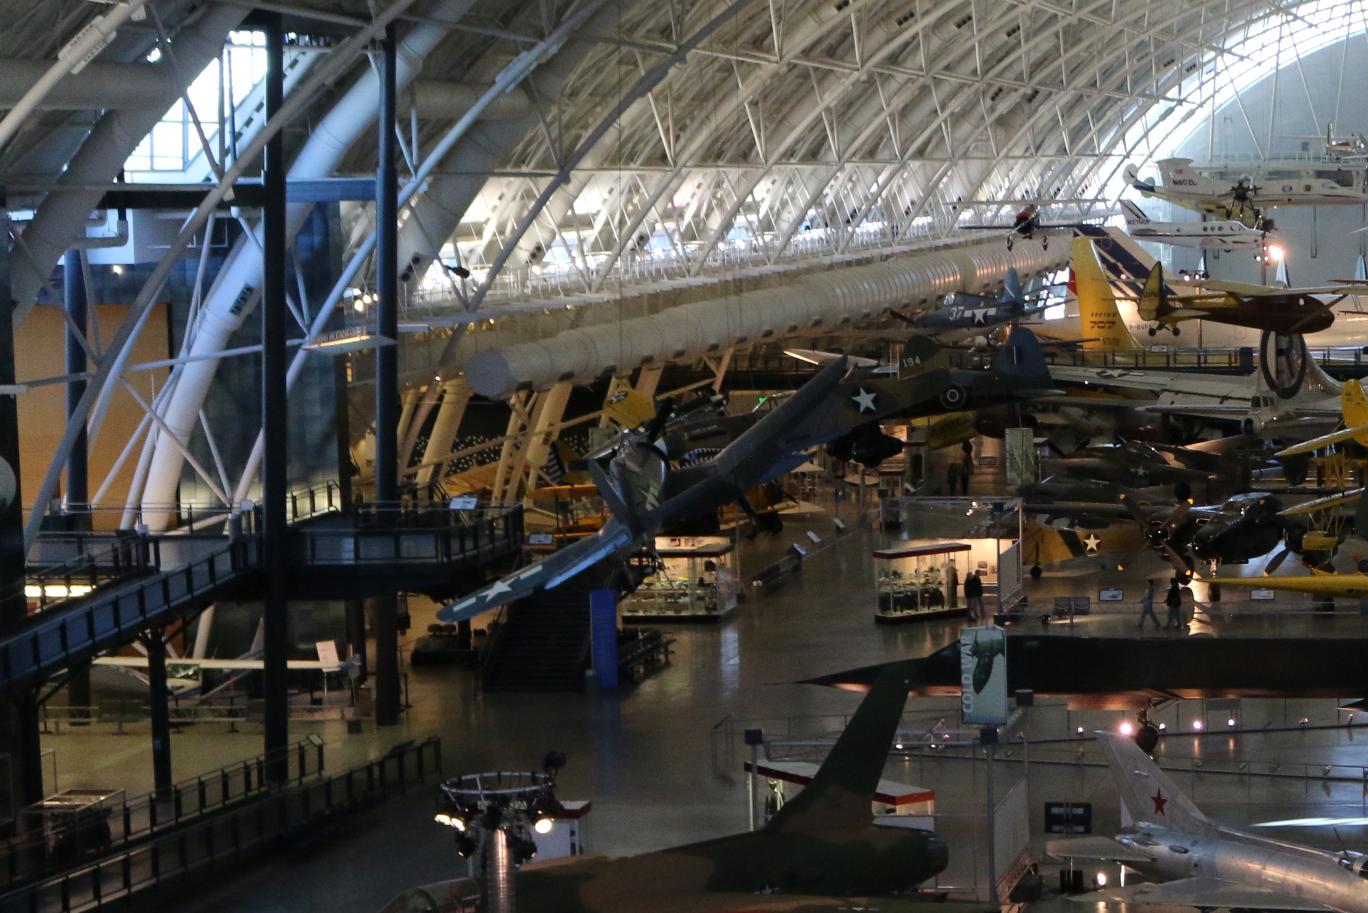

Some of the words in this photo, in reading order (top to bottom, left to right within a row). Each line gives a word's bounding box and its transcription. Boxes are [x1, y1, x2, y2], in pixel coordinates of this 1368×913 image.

[949, 306, 964, 321] 37
[1089, 320, 1116, 329] 707
[902, 354, 921, 369] 194
[961, 634, 974, 670] WAR
[961, 673, 974, 713] COLD
